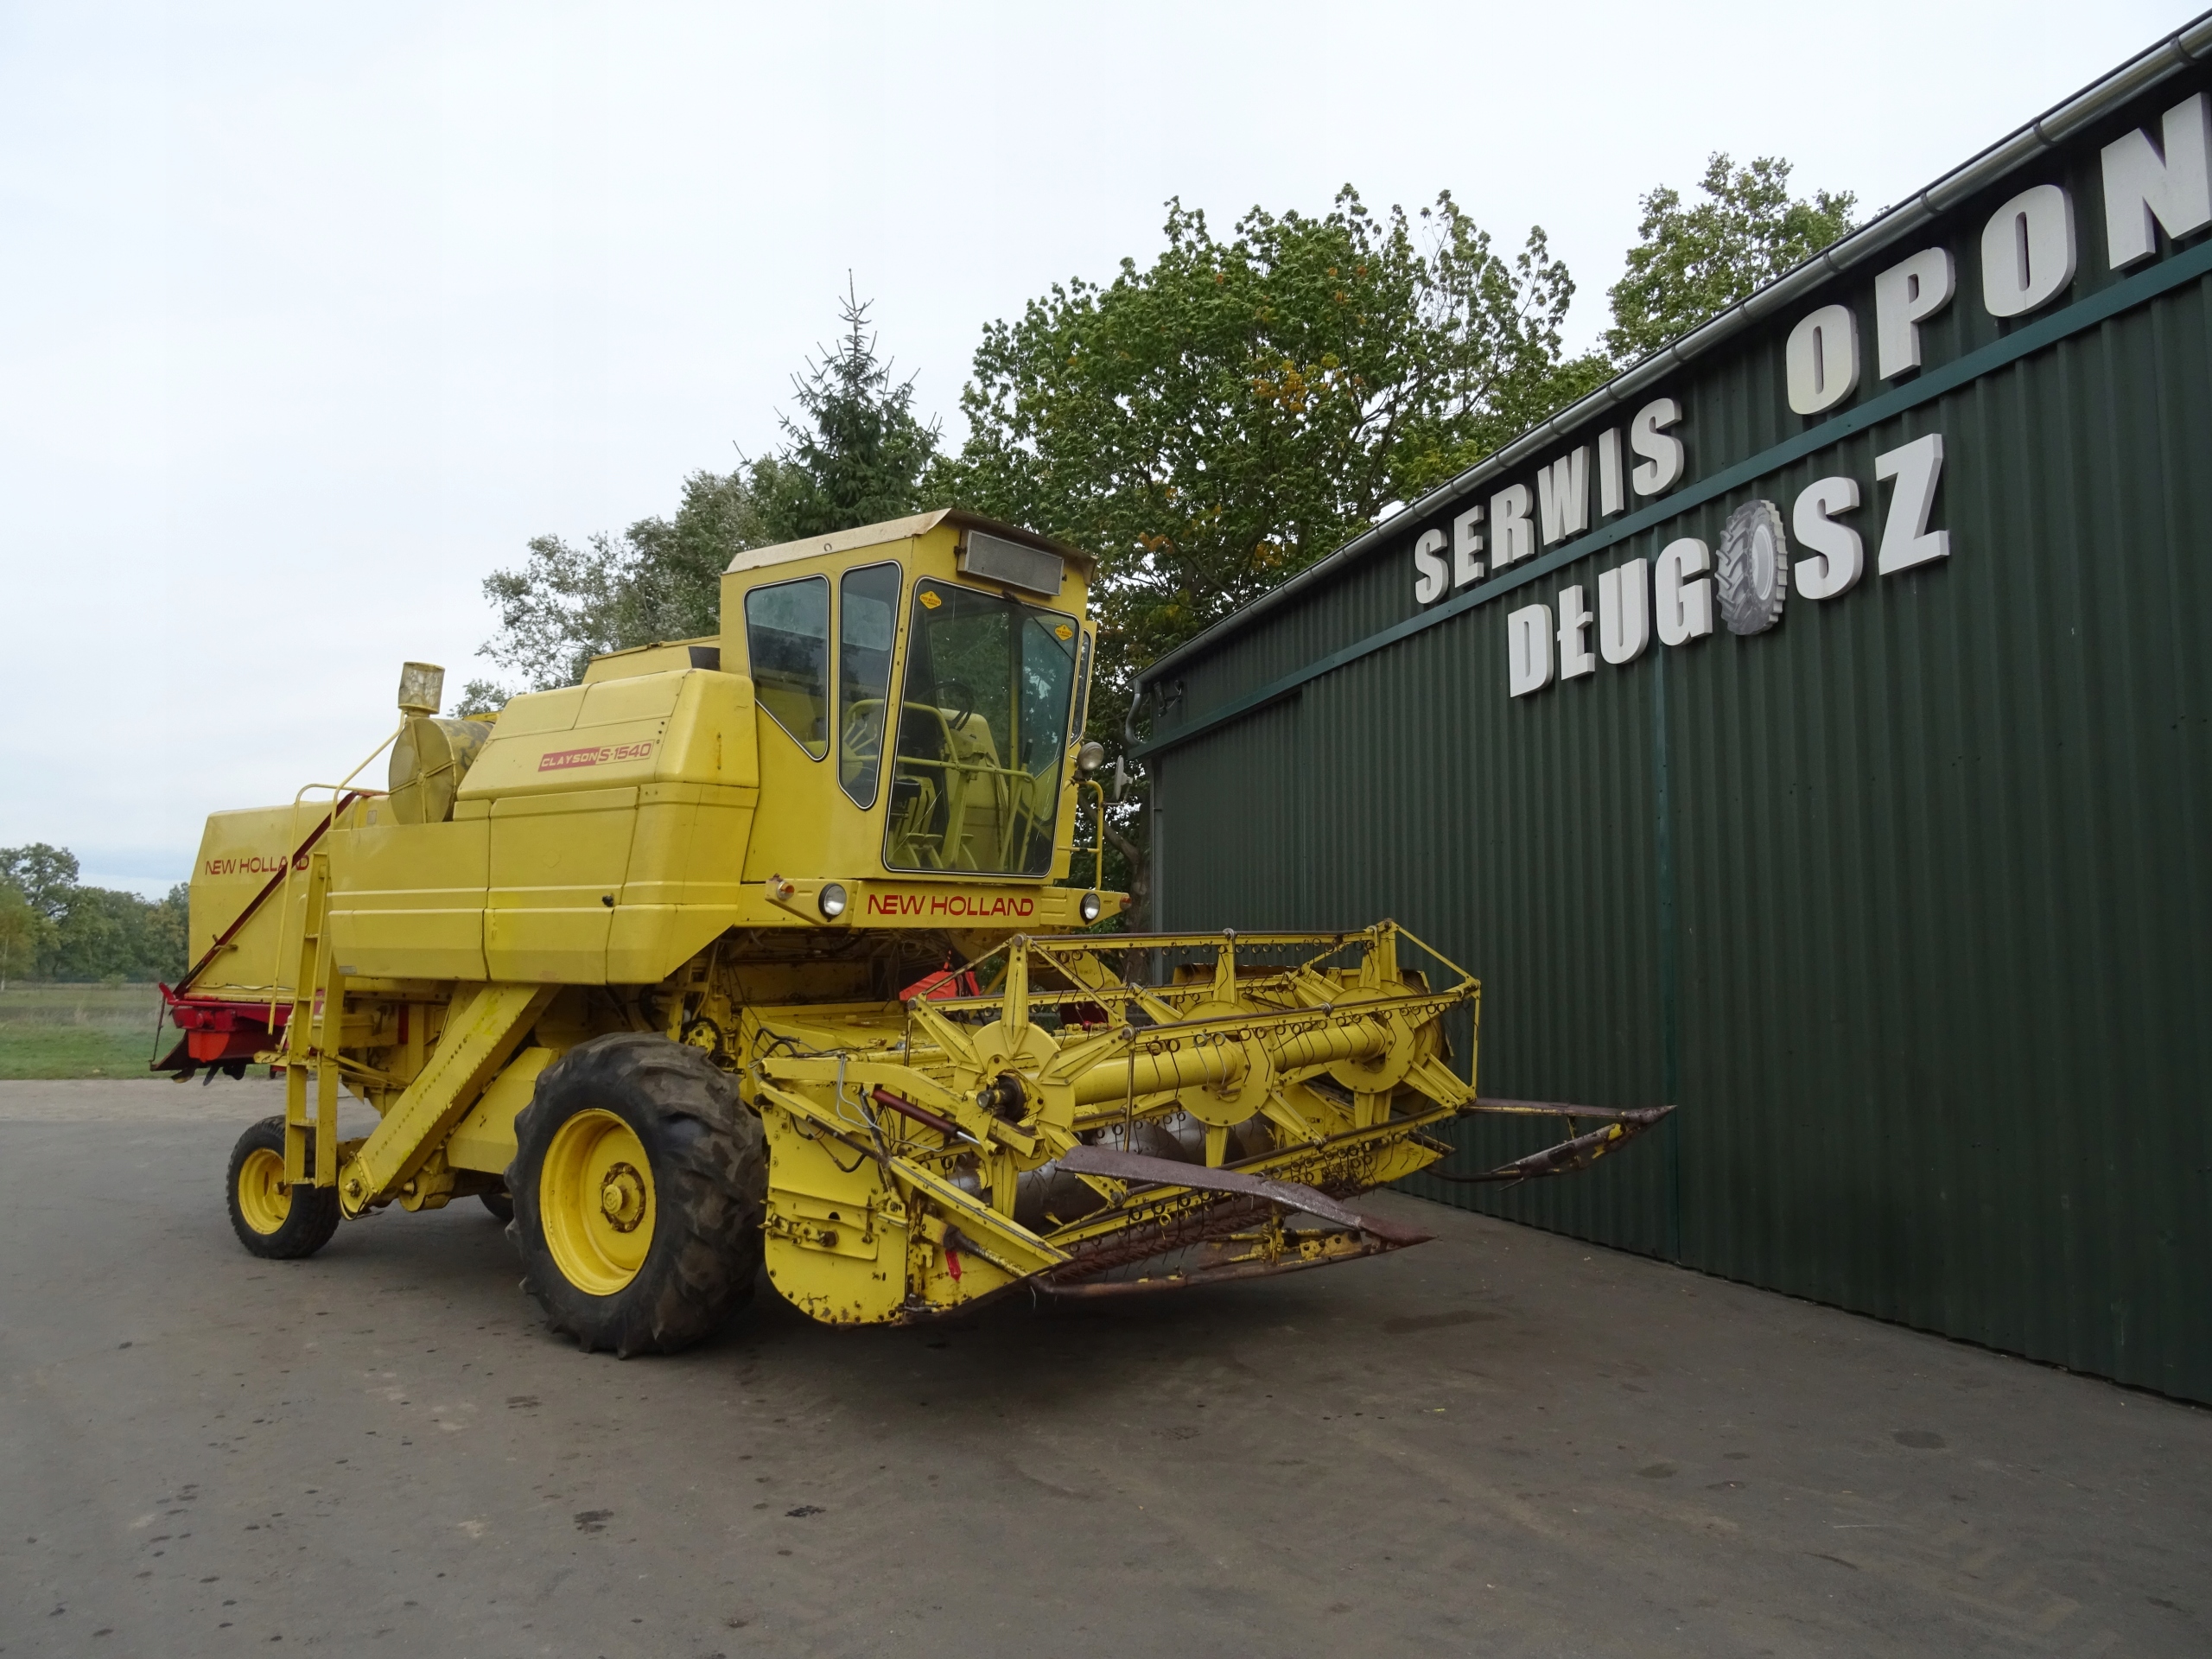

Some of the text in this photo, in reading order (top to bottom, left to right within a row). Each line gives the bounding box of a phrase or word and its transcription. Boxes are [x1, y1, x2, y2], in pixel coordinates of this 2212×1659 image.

[1414, 91, 2212, 605] SERWIS OPON
[541, 743, 652, 767] CLAYSON S-1540
[205, 858, 238, 875] NEW
[868, 894, 1034, 916] NEW HOLLAND
